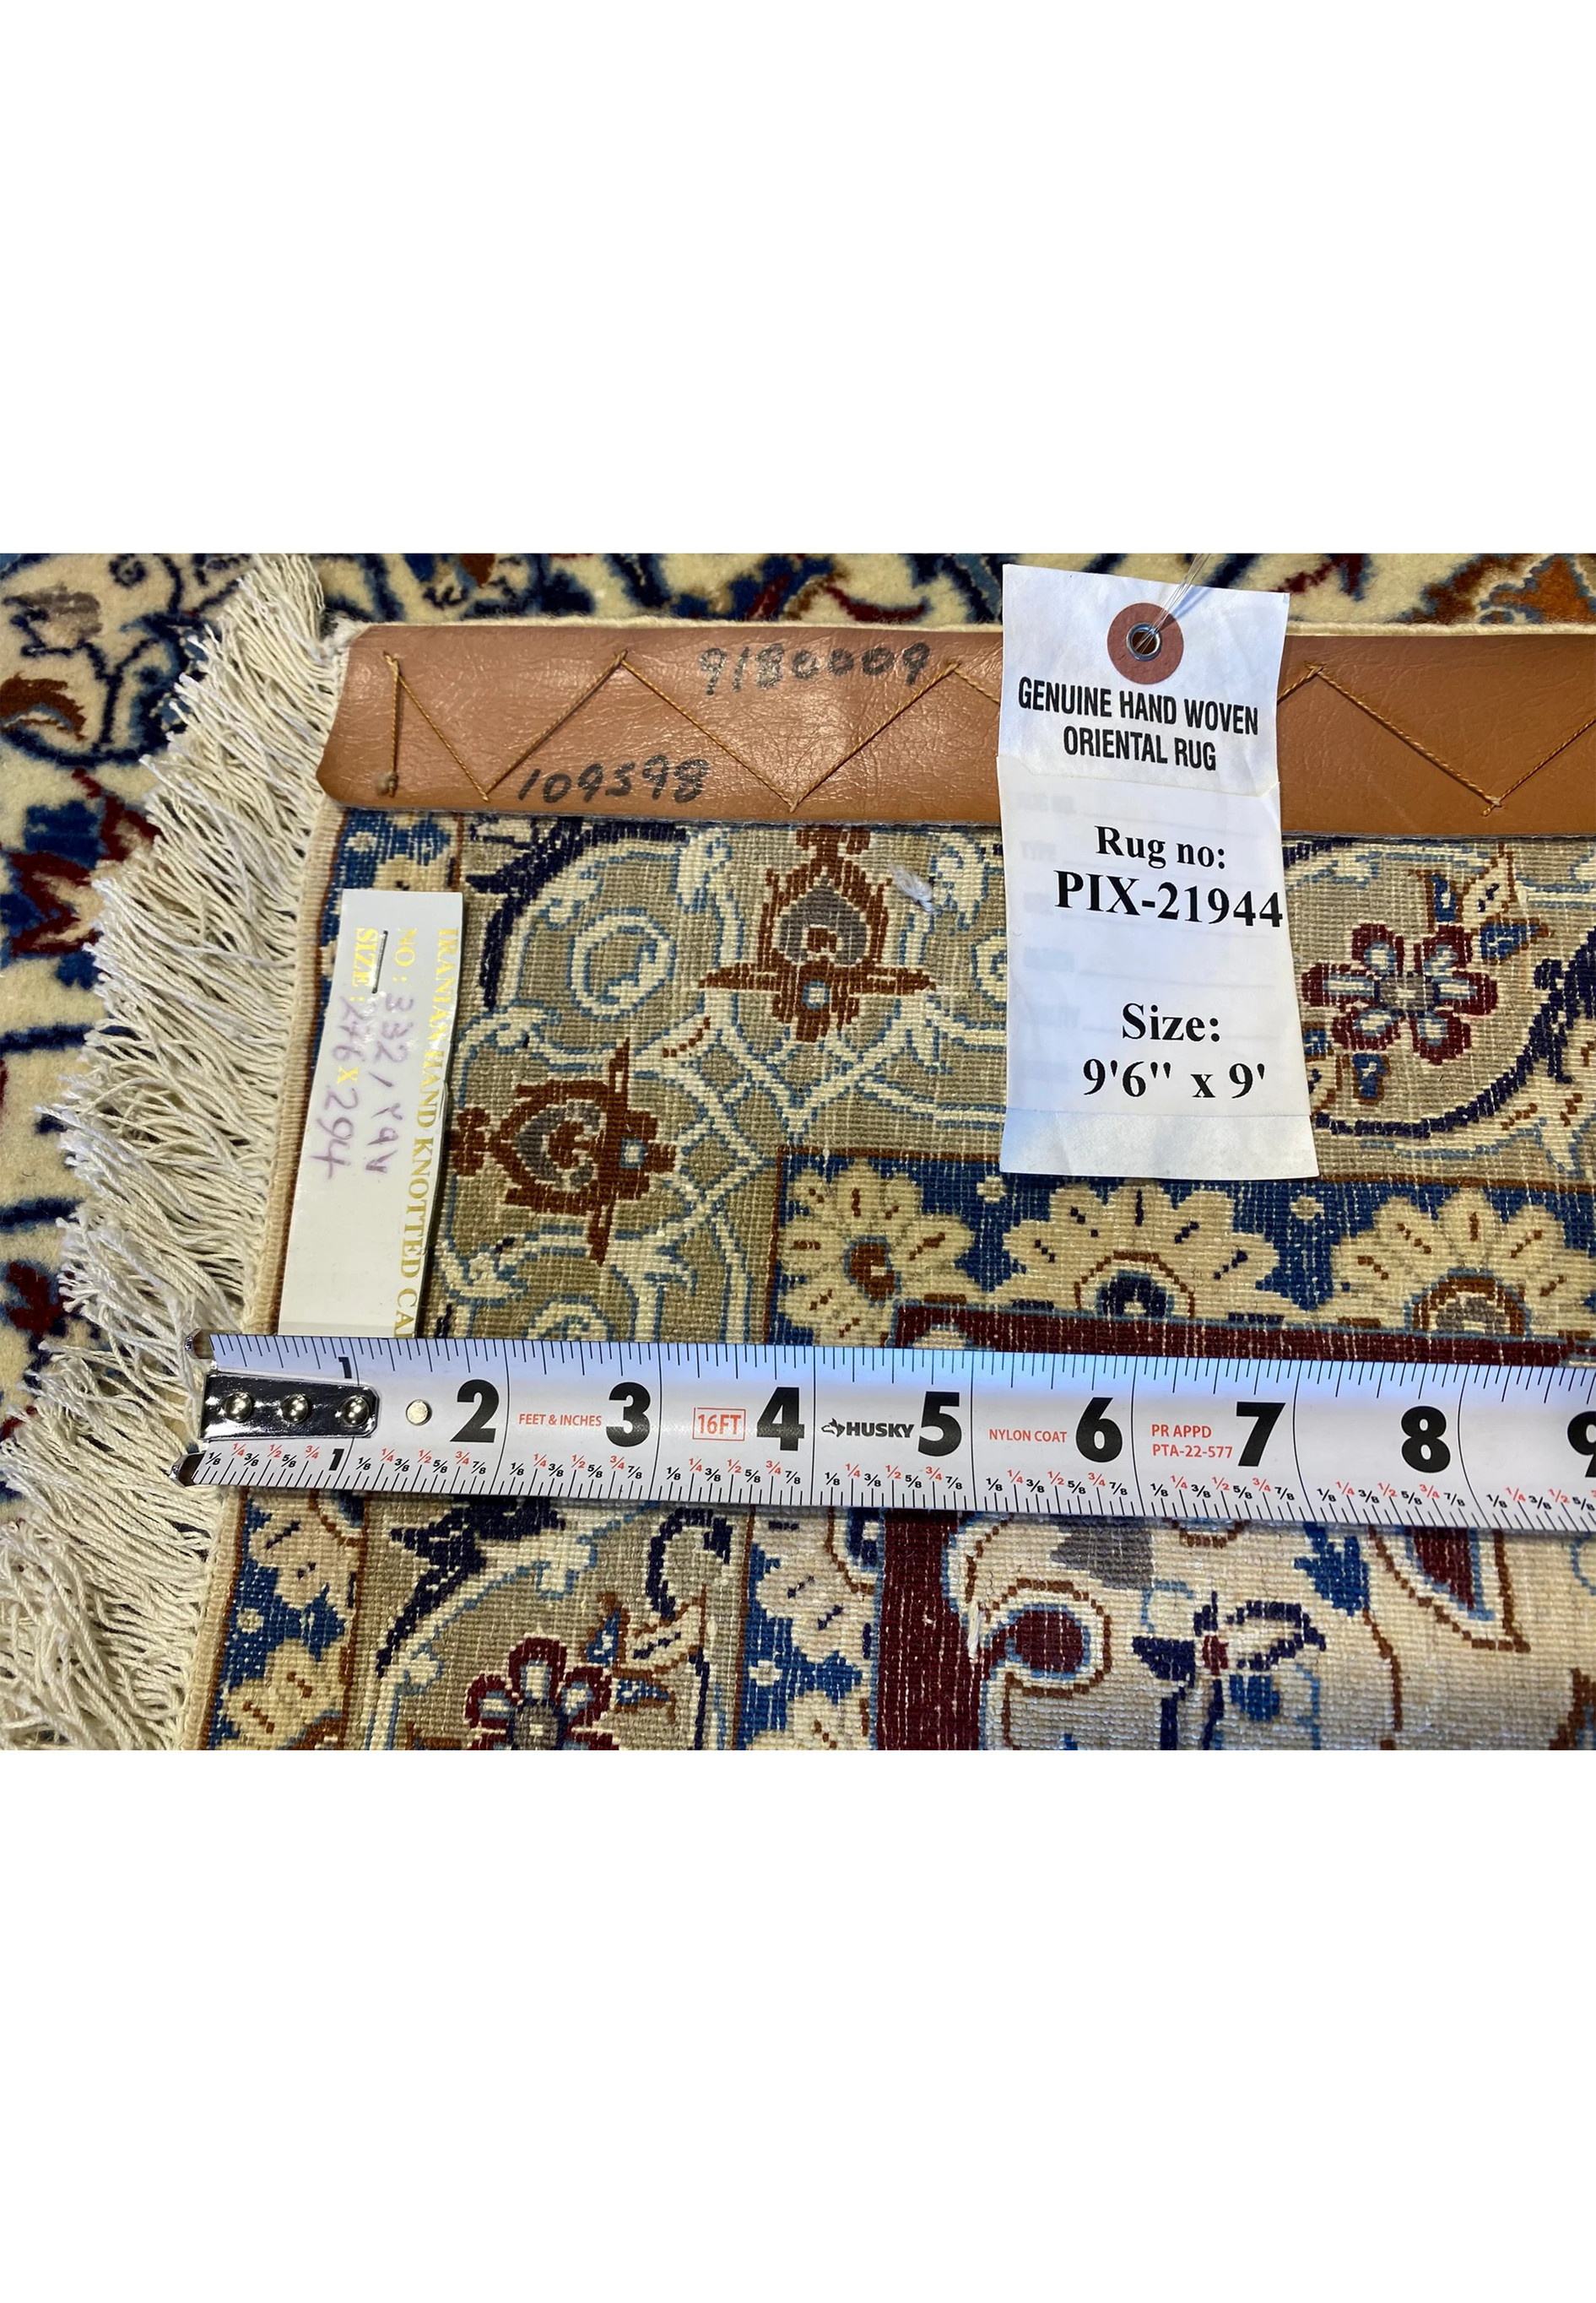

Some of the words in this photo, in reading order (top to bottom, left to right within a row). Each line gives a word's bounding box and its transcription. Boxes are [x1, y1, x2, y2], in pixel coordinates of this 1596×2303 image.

[699, 642, 930, 696] 9180009
[1019, 676, 1112, 717] GENUINE
[1119, 690, 1177, 725] HAND
[1183, 699, 1258, 735] WOVEN
[1063, 725, 1168, 764] ORIENTAL
[1174, 738, 1216, 770] RUG
[518, 754, 711, 803] 109598
[1094, 825, 1166, 869] Rug
[1176, 842, 1225, 869] no:
[1052, 869, 1284, 927] PIX-21944
[427, 927, 458, 1041] IRANIAN
[1122, 1003, 1220, 1042] Size:
[417, 1050, 445, 1128] HAND
[1191, 1072, 1216, 1099] x
[1228, 1062, 1266, 1099] 9'
[310, 1085, 359, 1179] 294
[400, 1137, 434, 1279] KNOTTED
[393, 1288, 418, 1338] CA
[450, 1379, 500, 1443] 2
[518, 1413, 547, 1426] FEET
[547, 1414, 558, 1426] &
[560, 1414, 603, 1427] INCHES
[605, 1381, 652, 1448] 3
[697, 1413, 742, 1435] 16FT
[756, 1387, 805, 1452] 4
[846, 1422, 915, 1439] HUSKY
[917, 1391, 962, 1457] 5
[988, 1428, 1031, 1442] NYLON
[1034, 1430, 1068, 1443] COAT
[1075, 1397, 1123, 1463] 6
[1151, 1424, 1170, 1437] PR
[1173, 1425, 1212, 1439] APPD
[1236, 1401, 1286, 1468] 7
[1401, 1405, 1451, 1473] 8
[208, 1452, 222, 1468] 1/8
[234, 1442, 245, 1457] 1/4
[244, 1453, 259, 1469] 3/8
[270, 1445, 282, 1458] 1/2
[282, 1454, 297, 1469] 5/8
[306, 1445, 319, 1460] 3/4
[328, 1448, 344, 1471] 1
[356, 1457, 371, 1473] 1/8
[381, 1447, 395, 1462] 1/4
[395, 1458, 409, 1473] 3/8
[419, 1449, 432, 1463] 1/2
[433, 1460, 447, 1475] 5/8
[456, 1451, 470, 1464] 3/4
[472, 1462, 486, 1474] 7/8
[510, 1462, 524, 1478] 1/8
[533, 1453, 547, 1468] 1/4
[549, 1463, 564, 1477] 3/8
[572, 1454, 586, 1469] 1/2
[587, 1465, 603, 1478] 5/8
[611, 1455, 625, 1469] 3/4
[628, 1466, 642, 1479] 7/8
[667, 1467, 680, 1480] 1/8
[690, 1457, 703, 1473] 1/4
[705, 1468, 721, 1484] 3/8
[728, 1458, 742, 1473] 1/2
[745, 1469, 760, 1483] 5/8
[766, 1460, 782, 1475] 3/4
[786, 1471, 800, 1484] 7/8
[825, 1472, 840, 1485] 1/8
[846, 1463, 860, 1478] 1/4
[864, 1473, 881, 1489] 3/8
[885, 1465, 901, 1480] 1/2
[906, 1475, 922, 1488] 5/8
[926, 1466, 943, 1481] 3/4
[946, 1476, 962, 1489] 7/8
[987, 1478, 1003, 1491] 1/8
[1008, 1469, 1023, 1484] 1/4
[1026, 1479, 1044, 1493] 3/8
[1048, 1470, 1064, 1485] 1/2
[1068, 1481, 1085, 1494] 5/8
[1089, 1472, 1106, 1486] 3/4
[1110, 1482, 1128, 1495] 7/8
[1150, 1484, 1168, 1496] 1/8
[1171, 1476, 1188, 1489] 1/4
[1192, 1484, 1210, 1498] 3/8
[1212, 1477, 1230, 1491] 1/2
[1233, 1485, 1252, 1499] 5/8
[1253, 1478, 1271, 1492] 3/4
[1275, 1487, 1295, 1500] 7/8
[1317, 1489, 1336, 1501] 1/8
[1336, 1481, 1355, 1495] 1/4
[1358, 1489, 1379, 1503] 3/8
[1379, 1481, 1396, 1498] 1/2
[1401, 1491, 1422, 1505] 5/8
[1420, 1483, 1440, 1500] 3/4
[1444, 1493, 1465, 1506] 7/8
[1487, 1495, 1507, 1508] 1/8
[1506, 1487, 1527, 1501] 1/4
[1528, 1496, 1551, 1509] 3/8
[1549, 1489, 1569, 1504] 1/2
[1152, 1444, 1233, 1458] PTA-22-577
